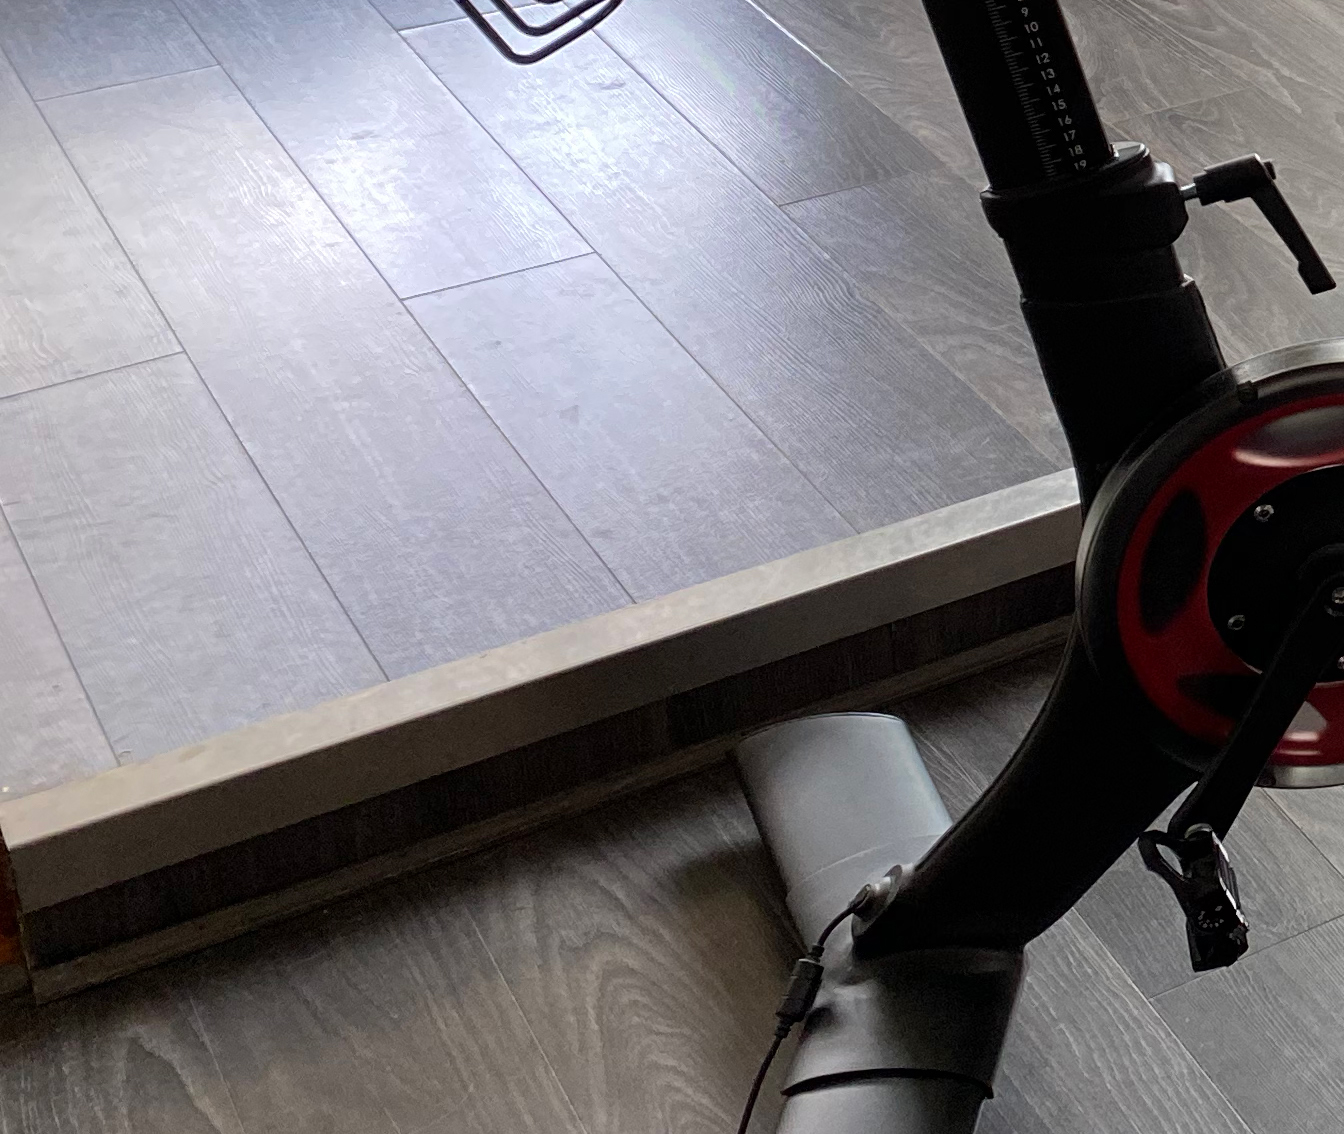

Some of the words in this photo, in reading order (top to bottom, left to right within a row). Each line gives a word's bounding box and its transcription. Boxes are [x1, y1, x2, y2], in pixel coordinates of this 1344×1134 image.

[1021, 7, 1029, 17] 9
[1024, 21, 1039, 33] 10
[1030, 37, 1043, 48] 11
[1035, 52, 1050, 64] 12
[1040, 68, 1055, 80] 13
[1046, 84, 1061, 96] 14
[1052, 99, 1067, 111] 15
[1058, 115, 1072, 126] 16
[1063, 130, 1076, 141] 17
[1068, 145, 1083, 157] 18
[1074, 160, 1087, 171] 19
